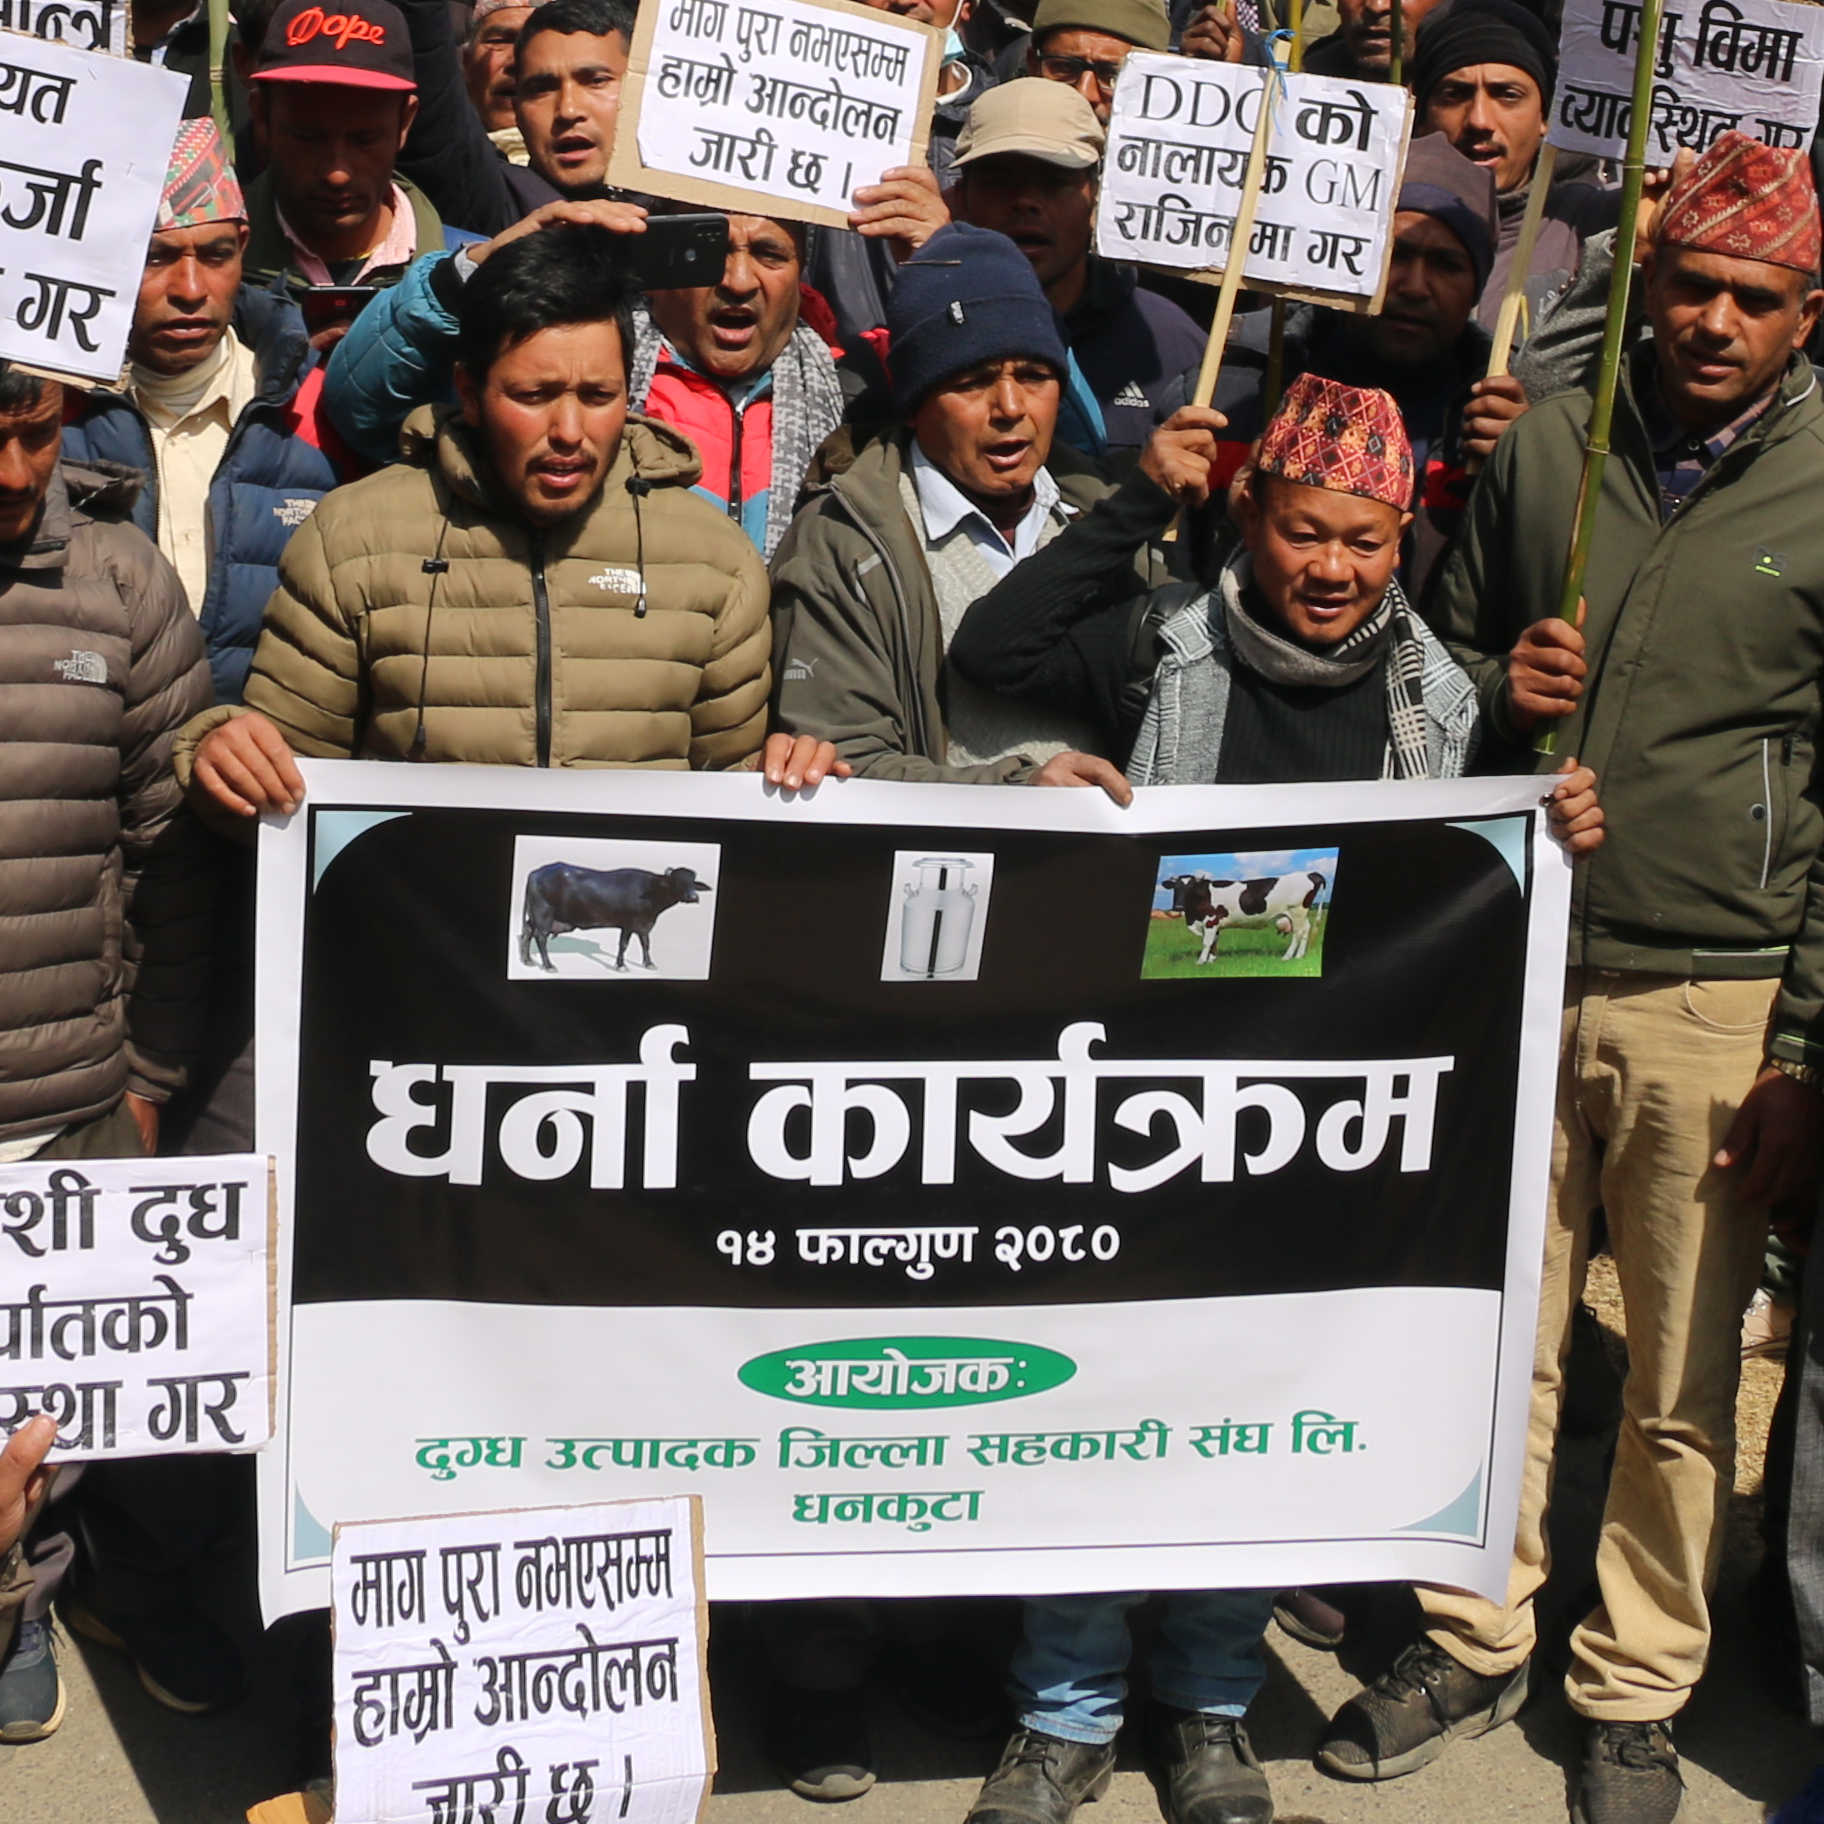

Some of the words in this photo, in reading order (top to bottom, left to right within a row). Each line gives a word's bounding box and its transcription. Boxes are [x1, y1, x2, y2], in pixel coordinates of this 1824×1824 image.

[286, 7, 385, 50] Dope
[734, 5, 784, 65] पुरा
[788, 14, 912, 88] नभएसम्म
[657, 53, 734, 109] हाम्रो
[745, 67, 904, 146] आन्दोलन
[1295, 90, 1379, 152] को
[687, 125, 779, 184] जारी
[787, 146, 832, 194] छ
[1304, 157, 1382, 213] GM
[1307, 227, 1372, 276] गर
[14, 271, 116, 353] गर
[1114, 396, 1151, 408] adidas
[604, 568, 626, 577] THE
[366, 1023, 696, 1190] धर्ना
[746, 1021, 1454, 1194] कार्यक्रम
[128, 1180, 249, 1266] दुध
[715, 1227, 776, 1266] १४
[795, 1226, 978, 1281] फाल्गुण
[992, 1224, 1121, 1271] २०८०
[147, 1371, 250, 1447] गर
[415, 1435, 527, 1483] दुग्ध
[545, 1435, 759, 1474] उत्पादक
[776, 1426, 948, 1472] जिल्ला
[966, 1418, 1170, 1466] सहकारी
[1188, 1417, 1274, 1457] संघ
[791, 1488, 983, 1532] धनकुटा
[349, 1549, 427, 1628] माग
[439, 1542, 503, 1646] पुरा
[516, 1527, 674, 1612] नभएसम्म
[351, 1637, 455, 1748] हाम्रो
[474, 1623, 679, 1724] आन्दोलन
